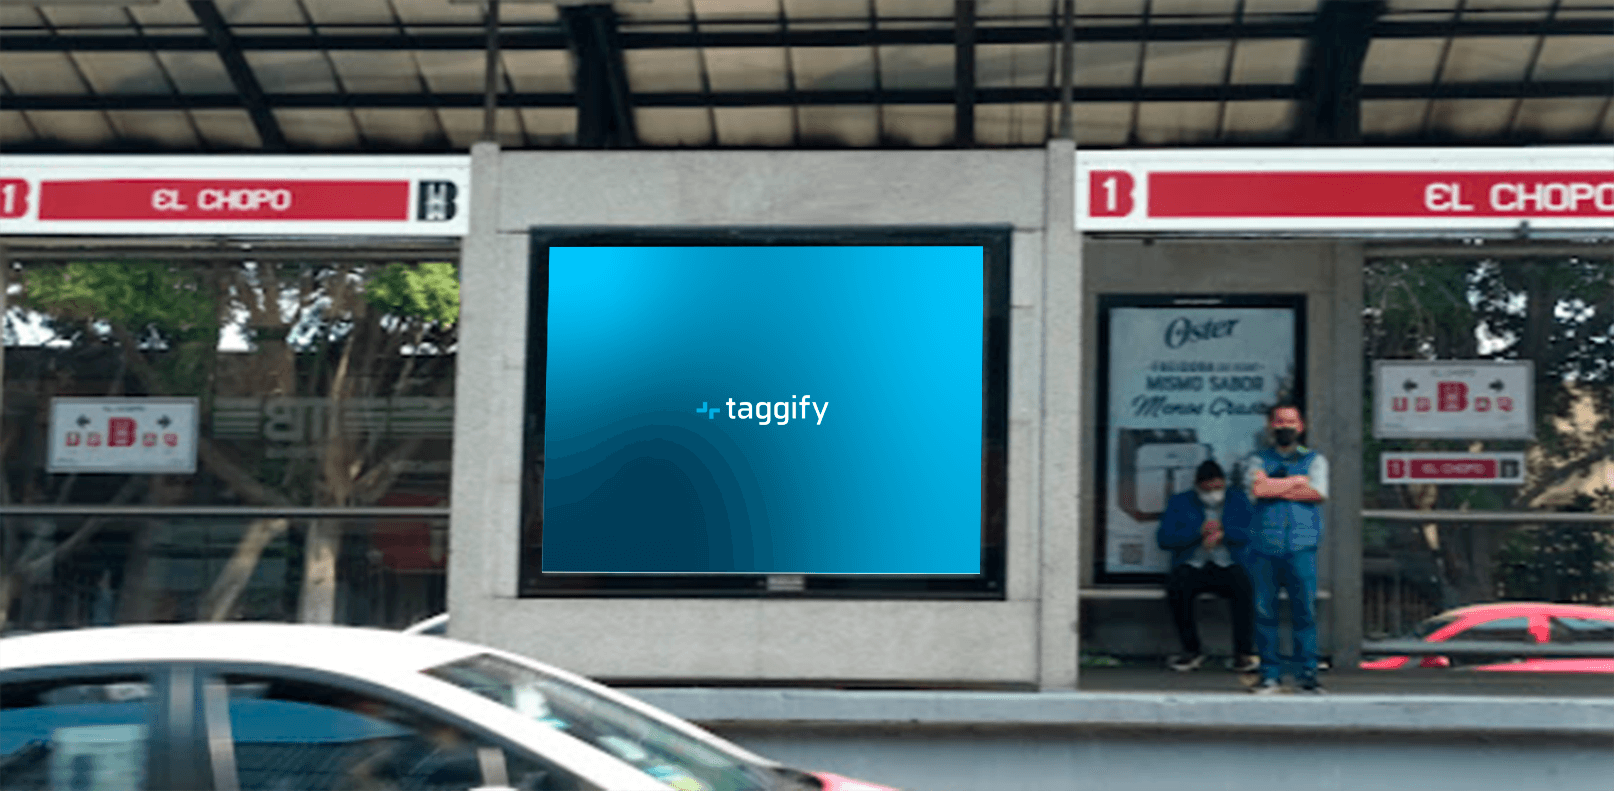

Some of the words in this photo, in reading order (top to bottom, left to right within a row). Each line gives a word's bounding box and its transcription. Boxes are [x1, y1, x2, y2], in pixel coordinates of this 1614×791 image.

[3, 184, 15, 214] 1
[151, 188, 188, 211] EL
[197, 188, 292, 211] CHOPO
[1102, 177, 1116, 211] 1
[1425, 182, 1474, 211] EL
[1490, 182, 1614, 211] CHOPO
[1164, 316, 1240, 349] Oster
[1146, 375, 1204, 391] MISMO
[1209, 375, 1264, 392] SABOR
[725, 394, 829, 426] taggify
